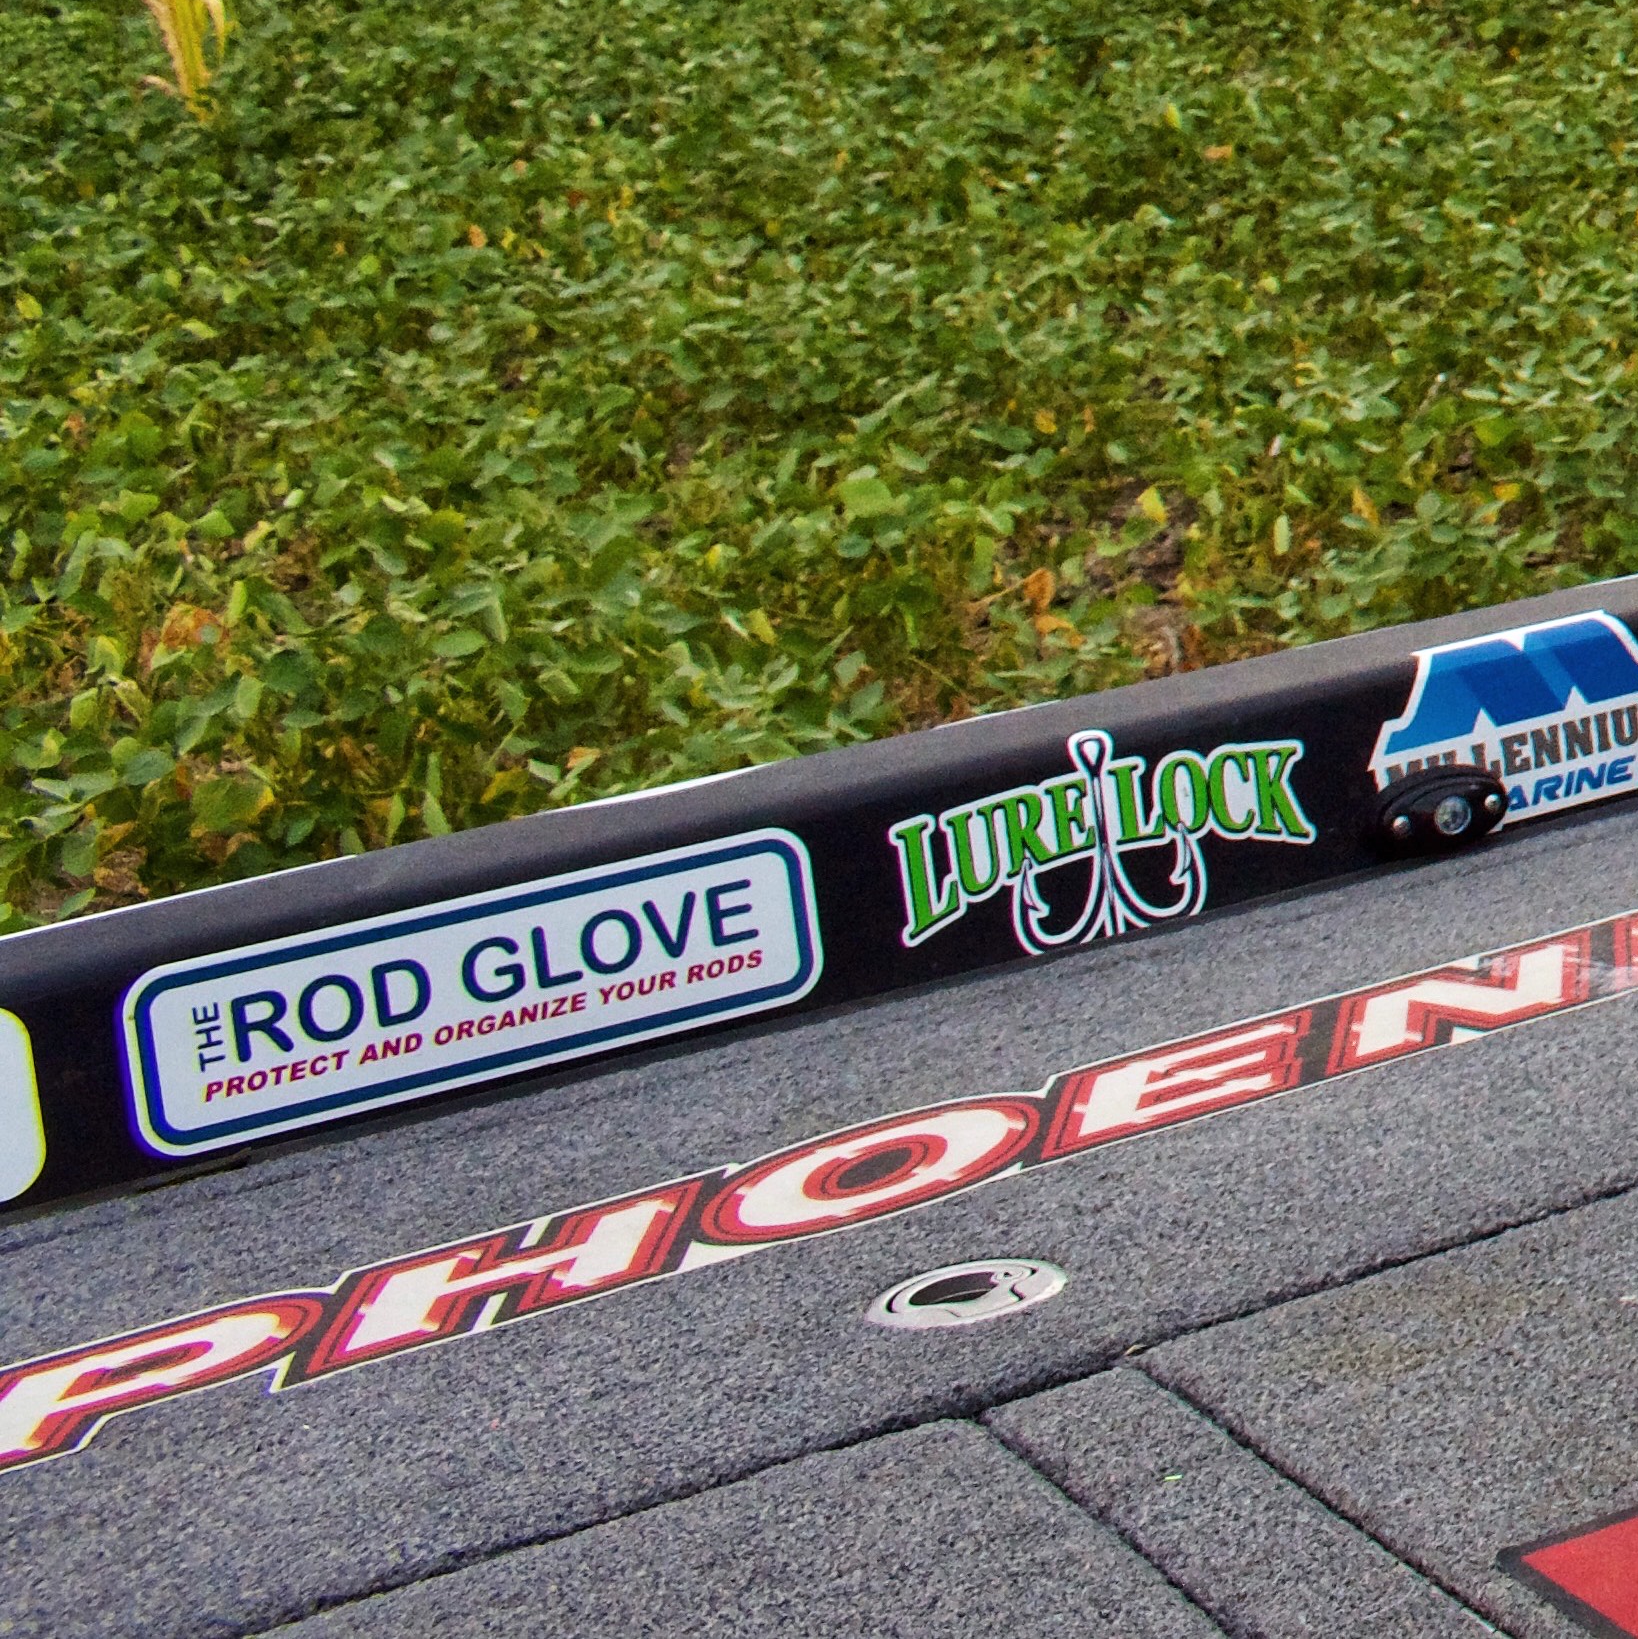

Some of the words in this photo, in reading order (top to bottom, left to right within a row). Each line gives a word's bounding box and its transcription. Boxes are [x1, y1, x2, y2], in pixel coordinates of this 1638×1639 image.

[892, 777, 1097, 942] LURE
[1111, 746, 1314, 846] LOCK
[1507, 754, 1637, 812] ARINE
[195, 1002, 224, 1072] THE
[228, 957, 432, 1064] ROD
[460, 879, 760, 1003] GLOVE
[204, 1050, 351, 1102] PROTECT
[358, 1031, 424, 1065] AND
[434, 992, 588, 1048] ORGANIZE
[598, 971, 677, 1008] YOUR
[685, 948, 764, 989] RODS
